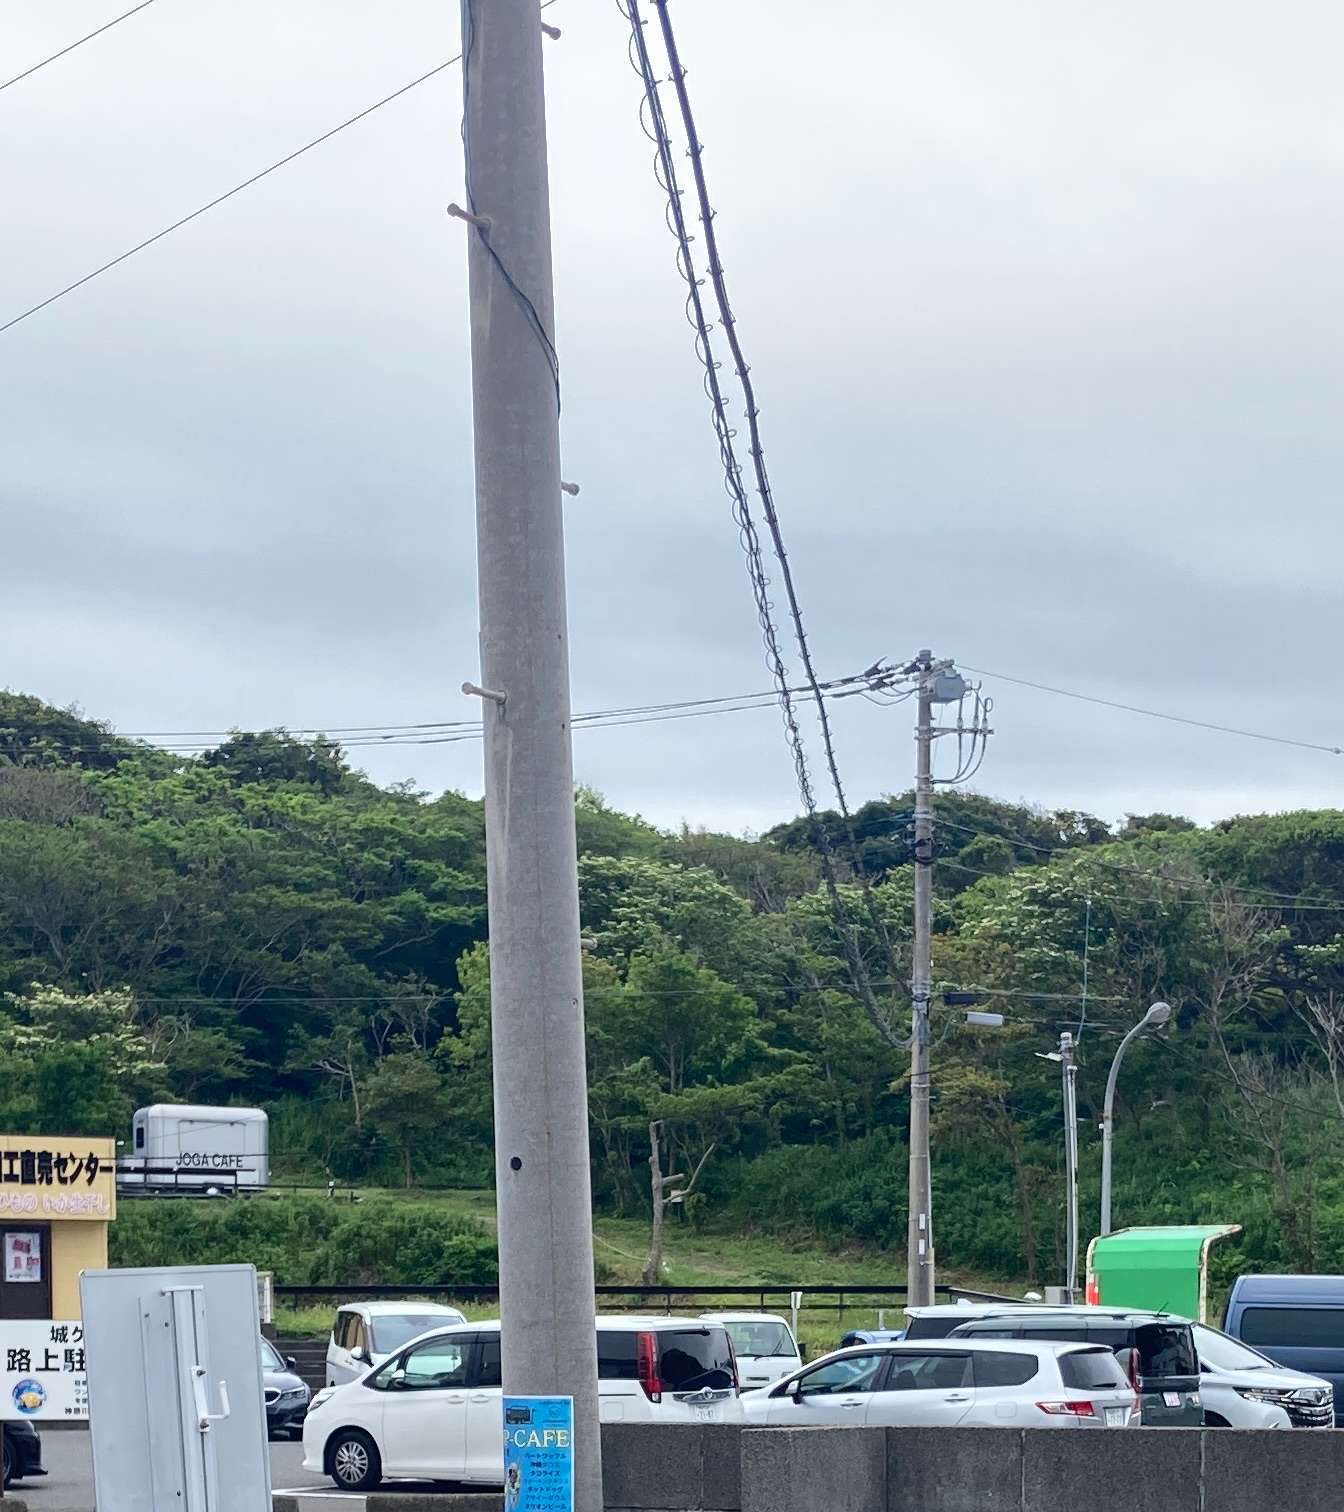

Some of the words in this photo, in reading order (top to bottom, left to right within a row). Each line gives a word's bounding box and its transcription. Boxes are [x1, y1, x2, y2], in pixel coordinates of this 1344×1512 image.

[176, 1152, 209, 1167] JOGA
[212, 1154, 244, 1168] CAFE
[6, 1348, 86, 1373] 路上駐
